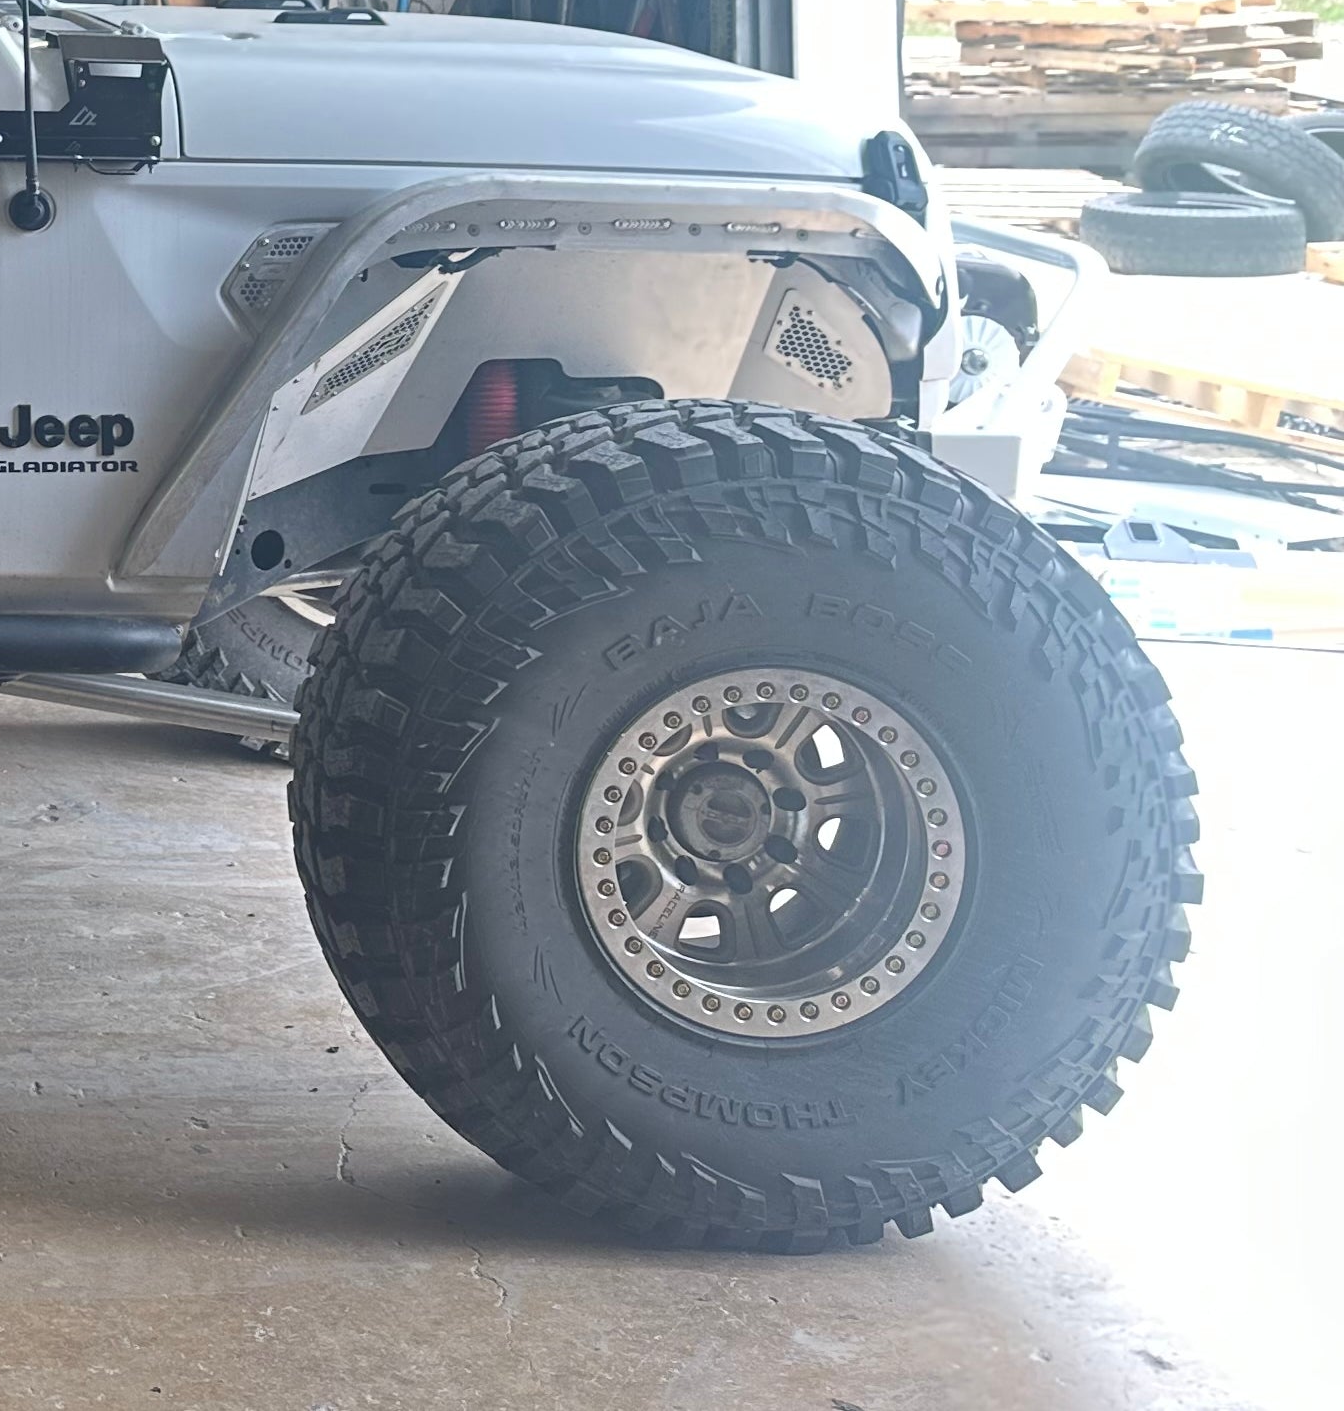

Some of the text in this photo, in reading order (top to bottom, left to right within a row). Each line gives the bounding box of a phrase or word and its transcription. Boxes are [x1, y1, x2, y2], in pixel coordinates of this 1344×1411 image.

[602, 590, 764, 672] BAJA
[647, 882, 687, 940] RACELINE
[567, 1014, 859, 1130] THOMPSON
